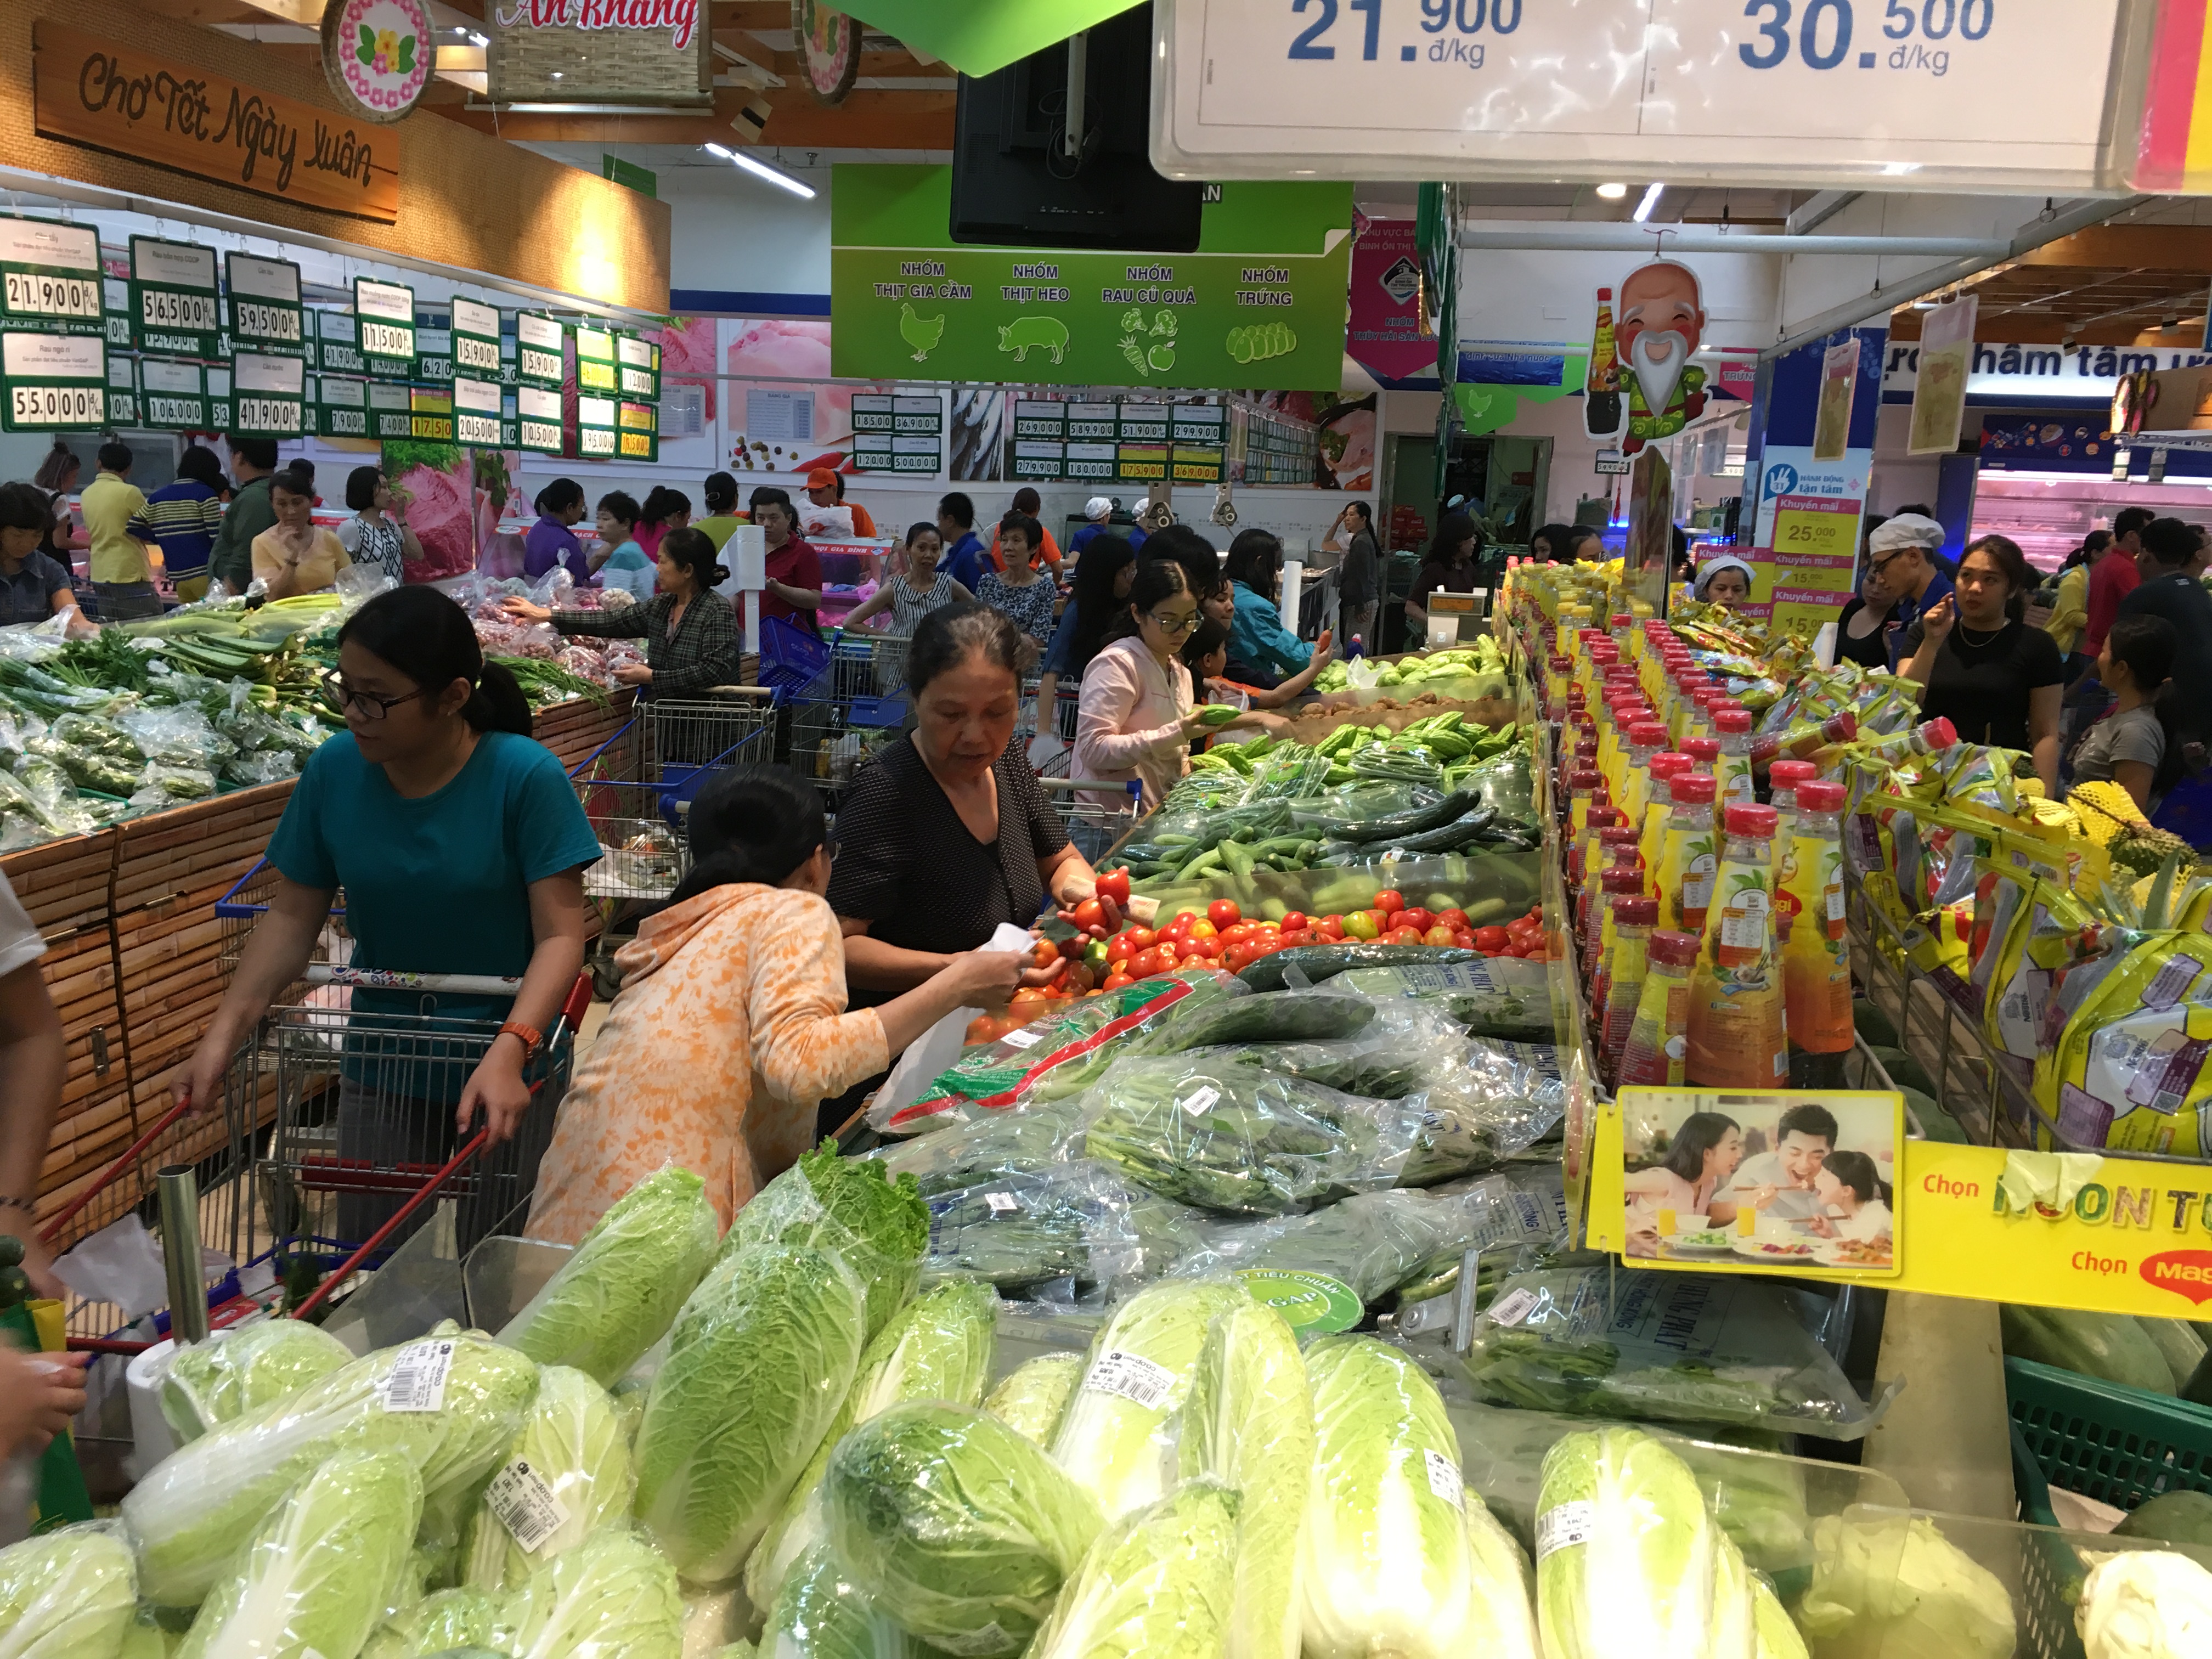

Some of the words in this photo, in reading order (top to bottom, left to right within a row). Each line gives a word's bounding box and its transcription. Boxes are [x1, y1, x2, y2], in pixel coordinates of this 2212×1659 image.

[1428, 38, 1486, 69] đ/kg
[1888, 44, 1950, 77] đ/kg
[80, 53, 151, 129] Chợ
[155, 71, 211, 142] Tết
[213, 87, 297, 191] Ngày
[304, 119, 372, 188] Xuân
[1404, 228, 1416, 236] BÁ
[901, 261, 945, 277] NHÓM
[1013, 263, 1059, 280] NHÓM
[1126, 265, 1173, 282] NHÓM
[1241, 266, 1289, 284] NHÓM
[8, 278, 81, 311] 21.900
[874, 283, 907, 300] THỊT
[909, 283, 936, 298] GIA
[938, 279, 972, 300] CẦM
[1000, 285, 1035, 302] THỊT
[1037, 286, 1070, 302] HEO
[1102, 289, 1135, 303] RAU
[1136, 287, 1159, 304] CỦ
[1161, 286, 1197, 306] QUẢ
[1235, 289, 1293, 307] TRỨNG
[145, 295, 202, 323] 56.500
[240, 306, 288, 330] 59.500
[1385, 316, 1415, 326] NHÓM
[364, 326, 402, 349] 11.500
[459, 341, 491, 364] 15.900
[424, 360, 452, 376] 6.20
[523, 353, 555, 373] 15.900
[16, 391, 86, 415] 55.000
[151, 400, 200, 420] 106.000
[240, 402, 289, 425] 41.900
[332, 413, 358, 427] 7.900
[856, 415, 890, 427] 185.00
[896, 416, 930, 428] 36.900
[415, 420, 451, 435] 17.50
[460, 419, 492, 438] 20.500
[523, 425, 555, 443] 10.500
[1019, 422, 1061, 433] 269.000
[1070, 423, 1113, 435] 589.900
[1122, 425, 1158, 436] 51.900
[1175, 426, 1218, 438] 299.900
[857, 455, 891, 466] 120.00
[895, 456, 937, 469] 500.000
[1018, 461, 1059, 473] 279.900
[1070, 463, 1111, 475] 180.000
[1122, 463, 1164, 476] 175.900
[1174, 465, 1218, 478] 369.000
[1799, 483, 1818, 494] tận
[1821, 484, 1843, 494] tâm
[1780, 497, 1819, 511] Khuyến
[1821, 501, 1839, 511] mãi
[1737, 549, 1754, 560] mãi
[1775, 553, 1814, 566] Khuyến
[1816, 556, 1833, 566] mãi
[1775, 590, 1814, 603] Khuyến
[1815, 593, 1834, 603] mãi
[1923, 1173, 1979, 1199] Chọn
[2072, 1250, 2128, 1276] Chọn
[1254, 1270, 1290, 1278] TIÊU
[1294, 1274, 1341, 1295] CHUẨN
[1267, 1291, 1318, 1308] GAP
